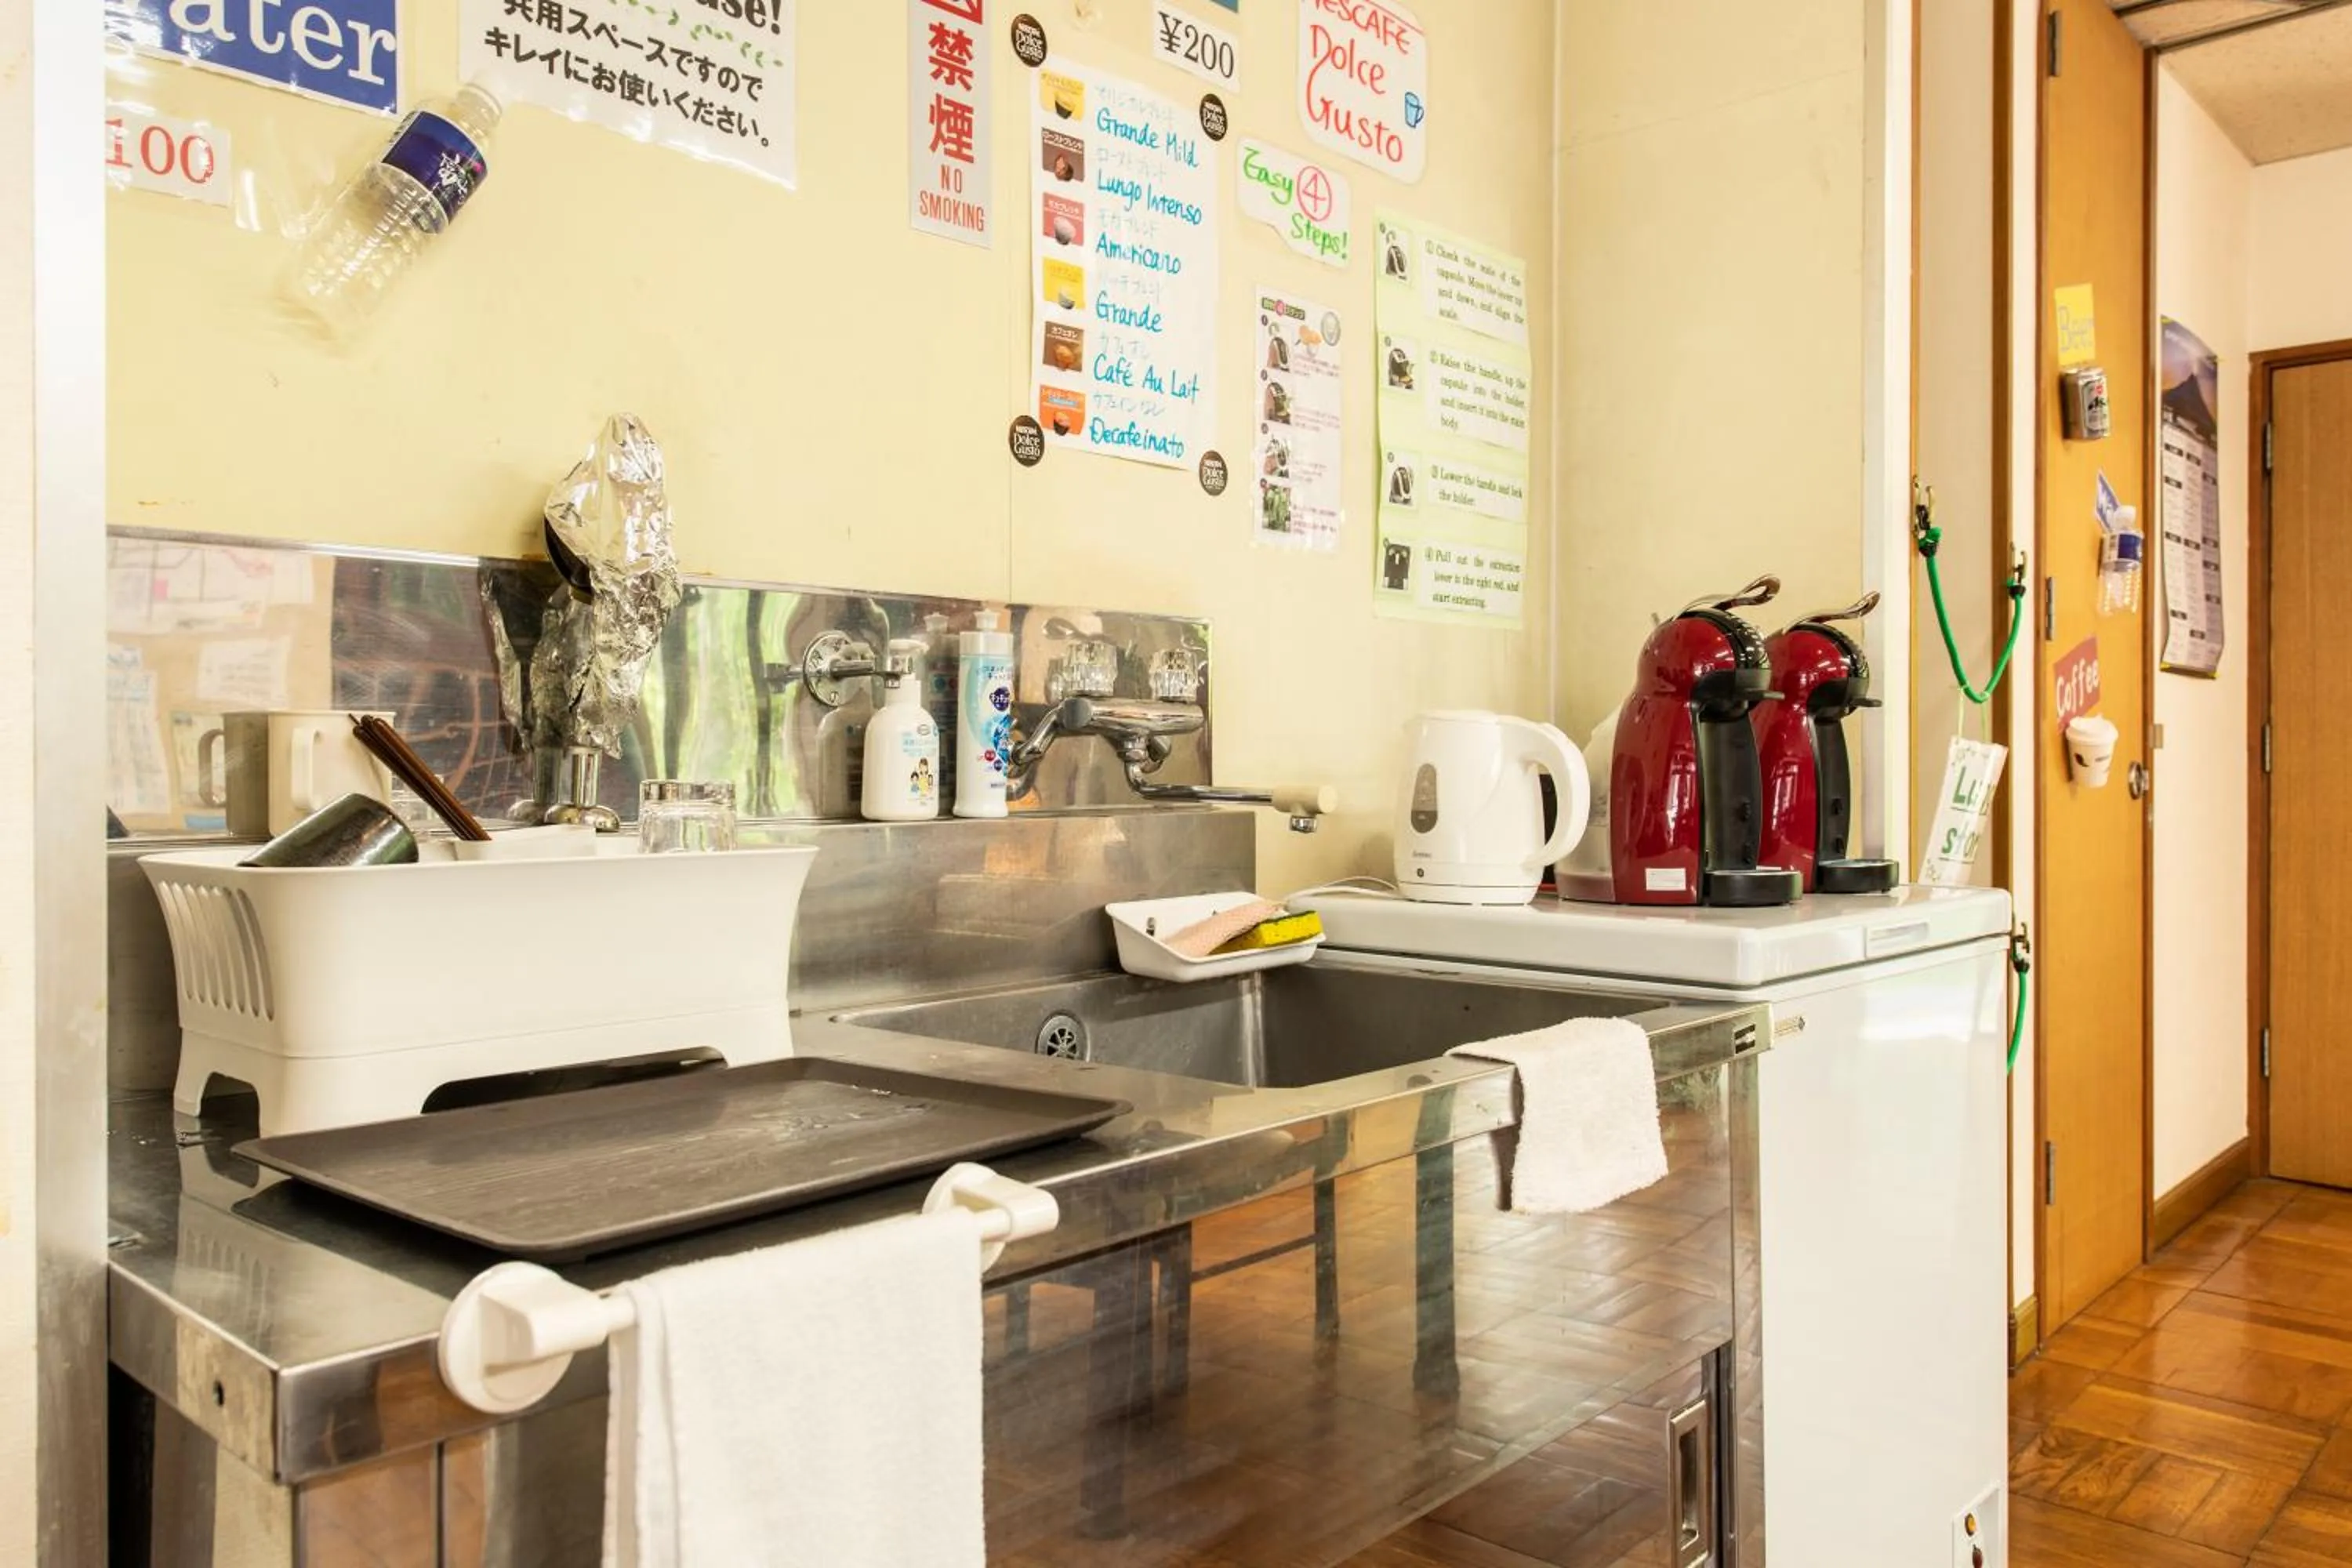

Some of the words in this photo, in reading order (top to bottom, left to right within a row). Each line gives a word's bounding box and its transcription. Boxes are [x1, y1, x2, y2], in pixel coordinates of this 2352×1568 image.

[165, 0, 397, 85] ater
[1158, 11, 1235, 79] ¥200
[1310, 24, 1385, 95] Dolce
[484, 26, 770, 147] キレイにお使いください。
[928, 22, 975, 164] 禁煙
[1096, 107, 1161, 150] Grande
[1166, 131, 1199, 168] Mild
[1307, 71, 1403, 163] Gusto
[941, 165, 963, 194] NO
[1097, 169, 1142, 212] Lungo
[1147, 183, 1202, 226] Intenso
[1243, 147, 1294, 205] Easy
[920, 191, 985, 232] SMOKING
[1292, 212, 1348, 260] Steps!
[1095, 232, 1182, 274] Americano
[1095, 290, 1163, 333] Grande
[1093, 353, 1133, 387] Café
[1142, 365, 1165, 394] Au
[1171, 369, 1200, 404] Lait
[1089, 417, 1185, 459] Decafeinato
[2056, 658, 2099, 717] Coffee
